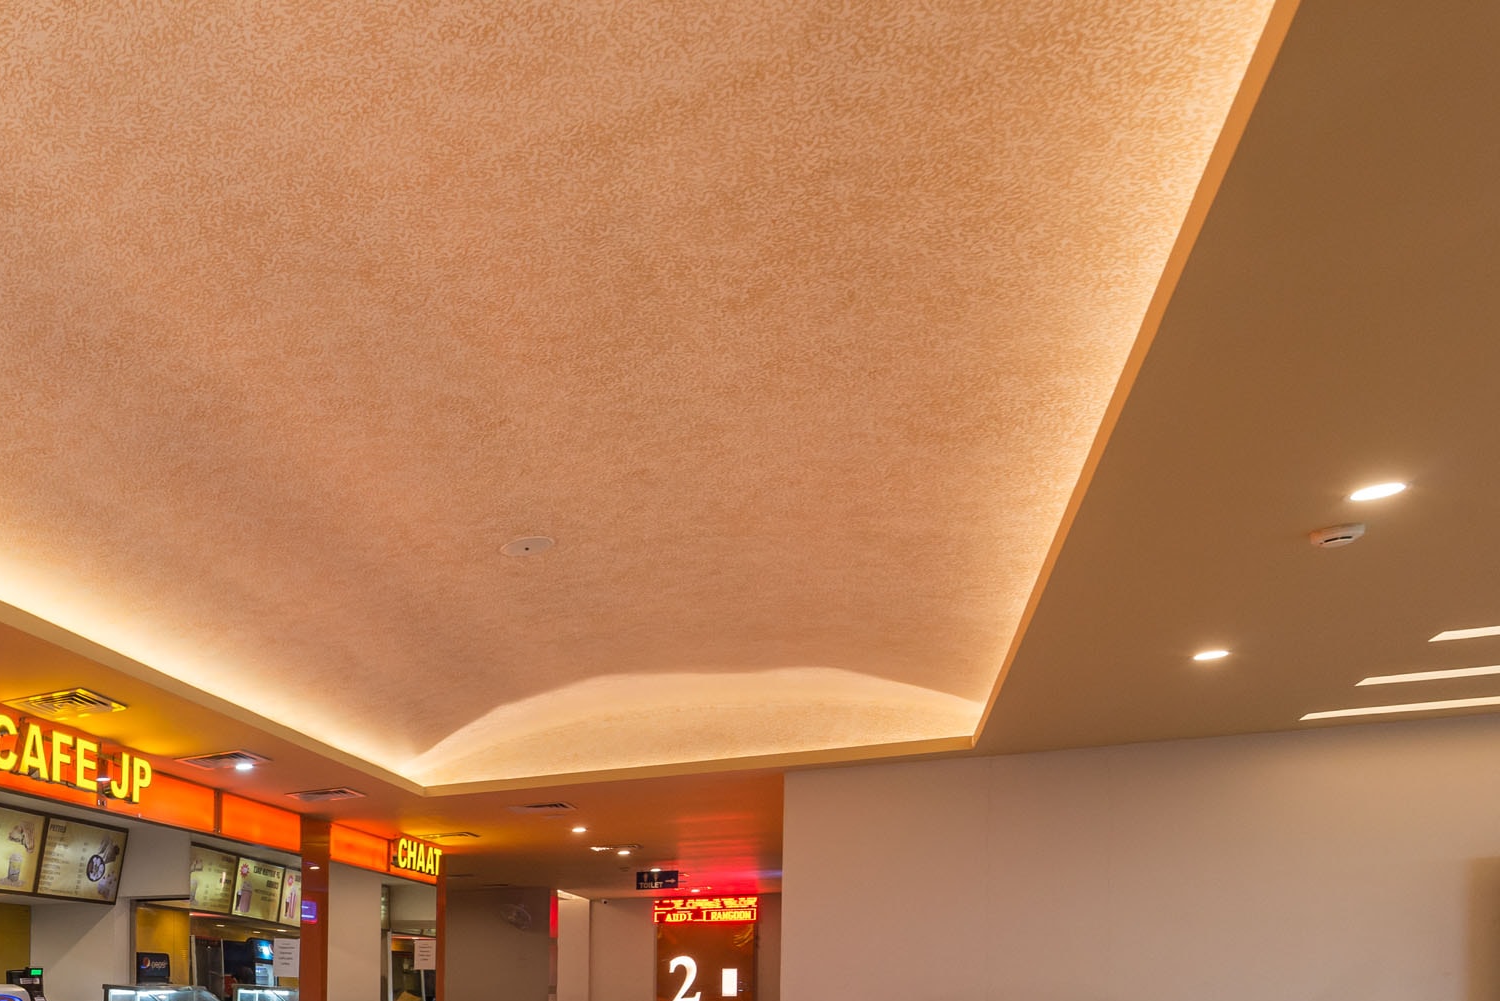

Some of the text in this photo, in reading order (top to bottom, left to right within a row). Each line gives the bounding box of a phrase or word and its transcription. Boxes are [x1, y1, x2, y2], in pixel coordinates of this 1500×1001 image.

[110, 751, 151, 803] JP
[397, 838, 442, 876] CHAAT
[639, 881, 663, 889] TOILET
